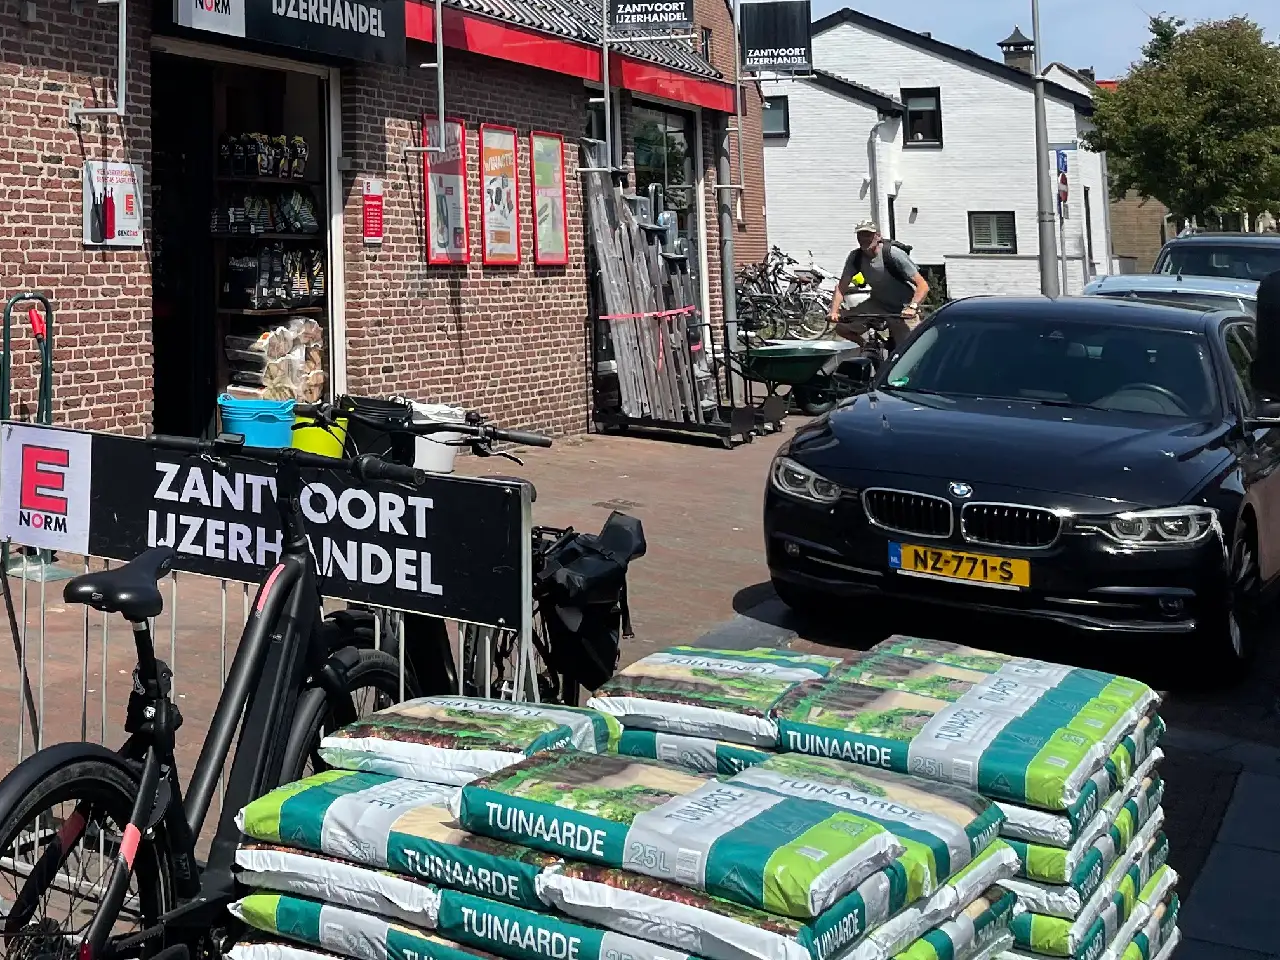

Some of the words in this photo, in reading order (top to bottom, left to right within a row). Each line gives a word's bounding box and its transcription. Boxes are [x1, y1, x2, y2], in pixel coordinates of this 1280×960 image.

[615, 11, 688, 25] IJZERHANDEL
[616, 1, 686, 14] ZANTVOORT
[746, 54, 809, 66] IJZERHANDEL
[747, 46, 806, 58] ZANTVOORT
[20, 443, 70, 515] E
[18, 510, 68, 534] NORM
[913, 549, 1014, 581] NZ-771-S
[786, 730, 893, 768] TUINAARDE
[778, 778, 925, 821] TUINAARDE
[485, 801, 607, 858] TUINAARDE
[403, 848, 521, 901] TUINAARDE
[461, 906, 582, 960] TUINAARDE
[813, 908, 860, 958] TUINAARDE
